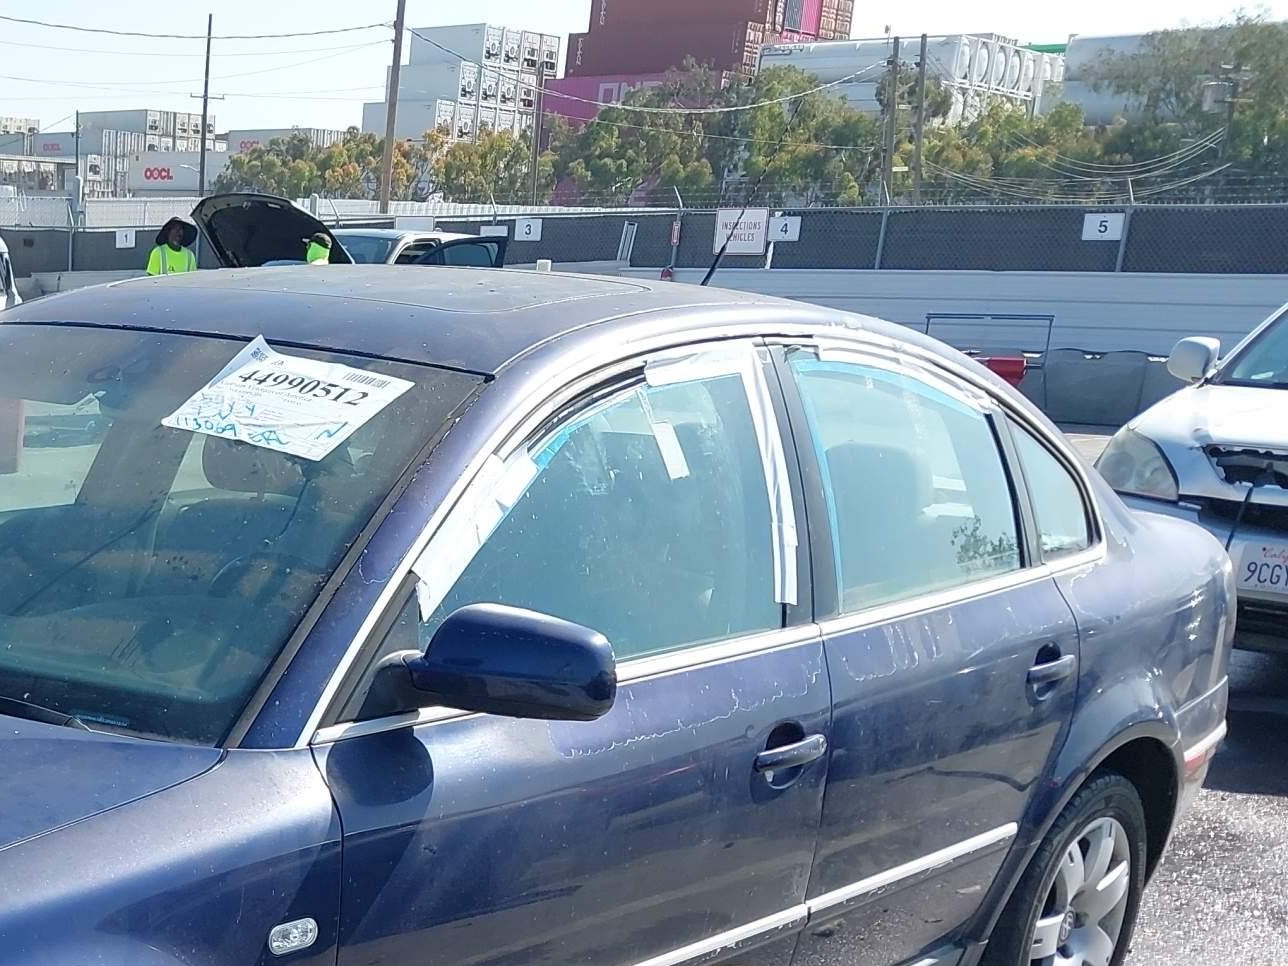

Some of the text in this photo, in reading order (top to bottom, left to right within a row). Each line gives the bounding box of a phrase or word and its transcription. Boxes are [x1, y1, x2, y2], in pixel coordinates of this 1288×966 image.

[598, 79, 664, 106] ON
[144, 167, 174, 181] OOCL
[524, 223, 533, 236] 3
[780, 222, 789, 235] 4
[1097, 220, 1109, 234] 5
[238, 369, 370, 407] 44990512
